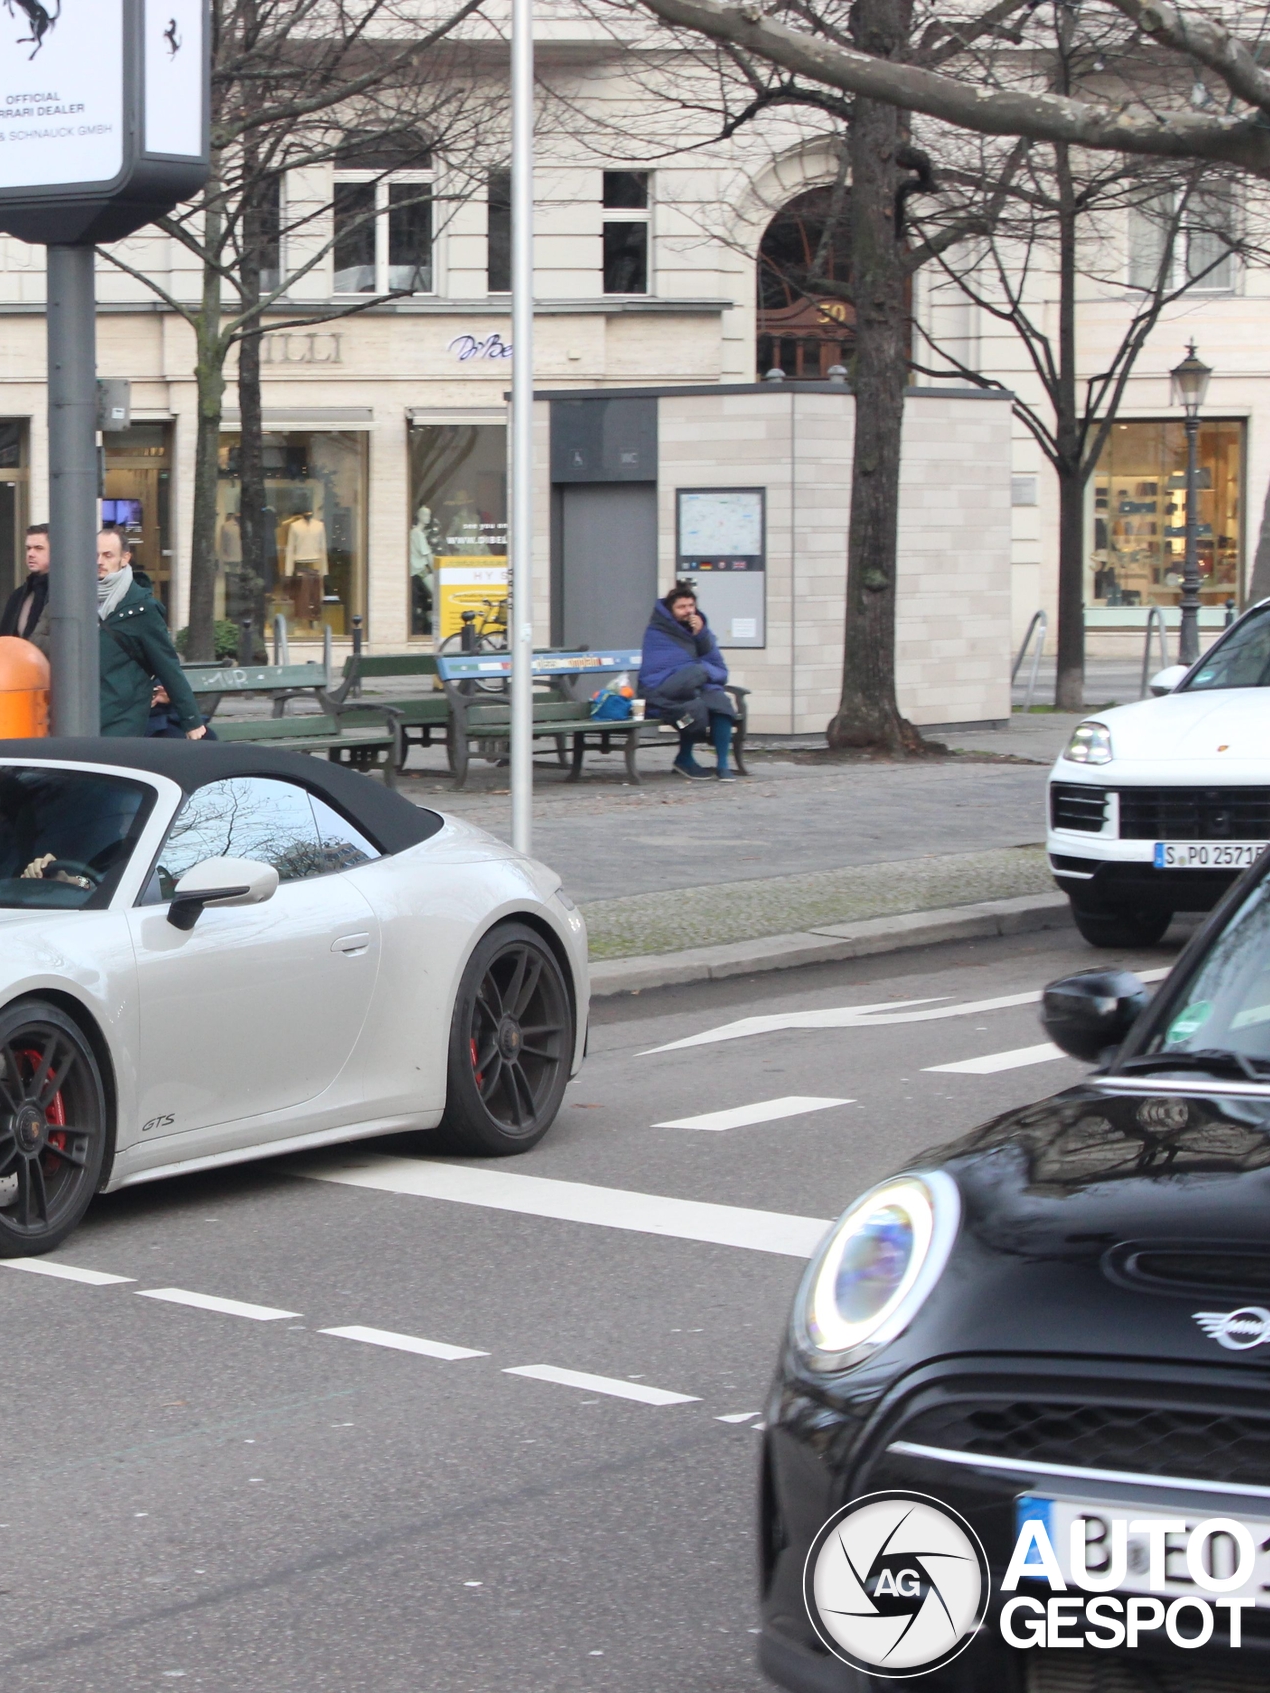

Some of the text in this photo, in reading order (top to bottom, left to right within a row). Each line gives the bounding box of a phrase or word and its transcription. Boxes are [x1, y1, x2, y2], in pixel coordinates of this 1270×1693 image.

[4, 92, 61, 105] OFFICIAL
[37, 103, 86, 117] DEALER
[9, 127, 75, 142] SCHNAUCK
[77, 124, 113, 137] GMBH
[817, 303, 846, 323] 50
[238, 332, 345, 364] ILLI
[620, 452, 638, 464] WC
[479, 523, 496, 531] you
[446, 536, 509, 545] WWW.DIBEL
[1166, 847, 1175, 864] S
[142, 1113, 176, 1132] GTS
